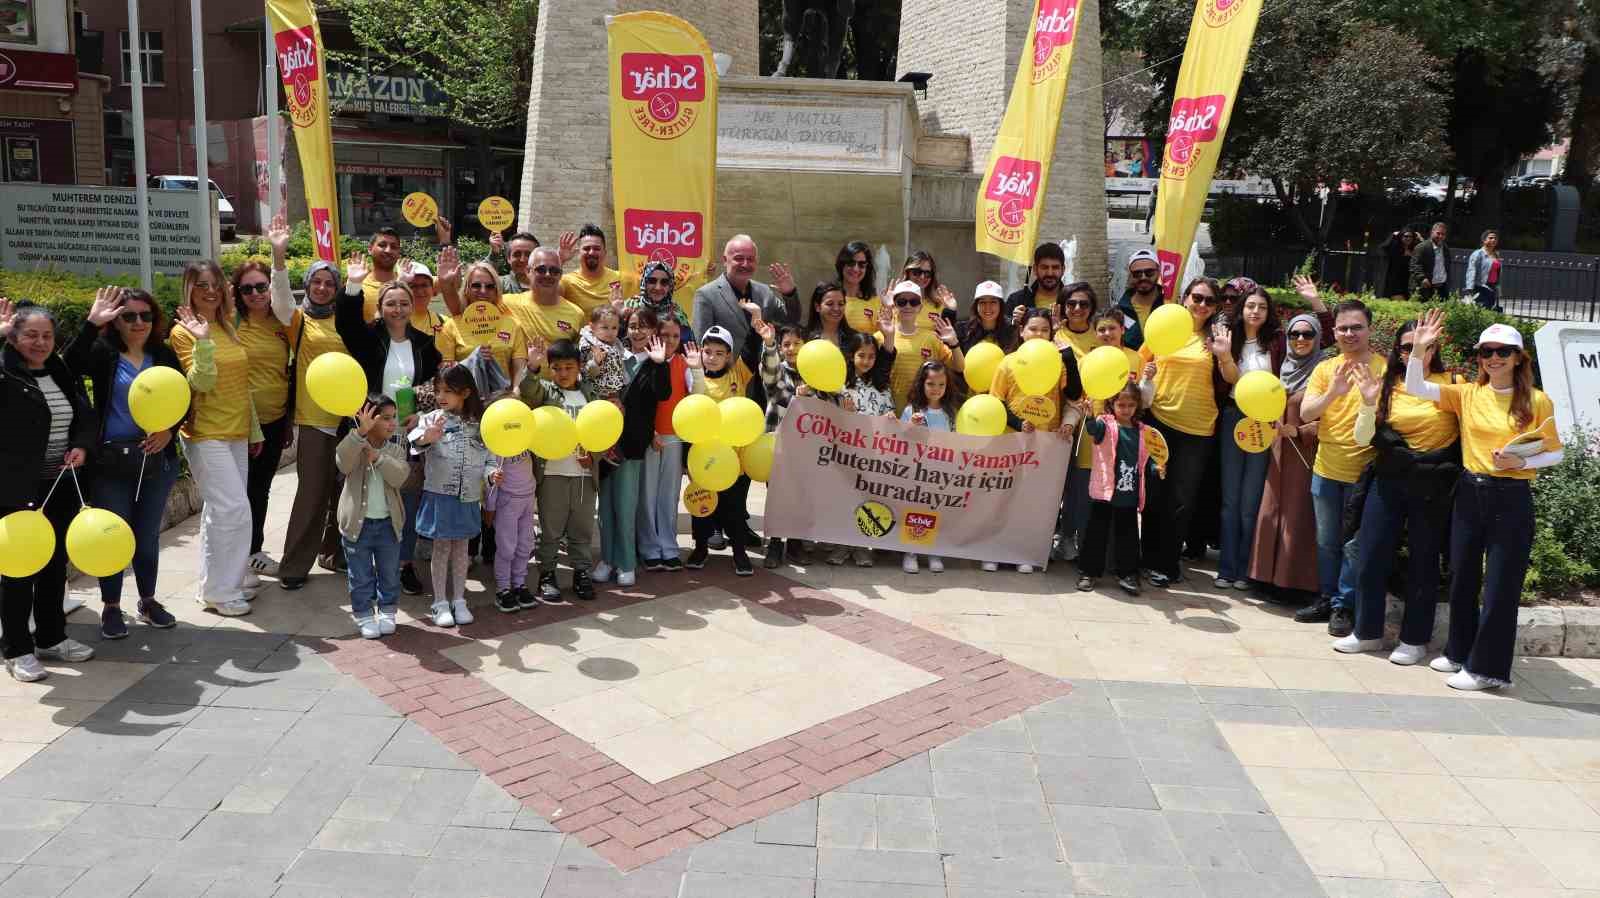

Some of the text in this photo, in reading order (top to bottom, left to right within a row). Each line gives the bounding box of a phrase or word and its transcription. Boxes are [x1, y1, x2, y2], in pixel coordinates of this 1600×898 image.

[786, 112, 841, 125] MUTLU
[52, 193, 152, 205] MUHTEREM DENİZLİR
[795, 412, 1040, 470] Çölyak için yan yanayız,
[817, 443, 1014, 492] glutensiz hayat için
[855, 473, 972, 510] buradayız!
